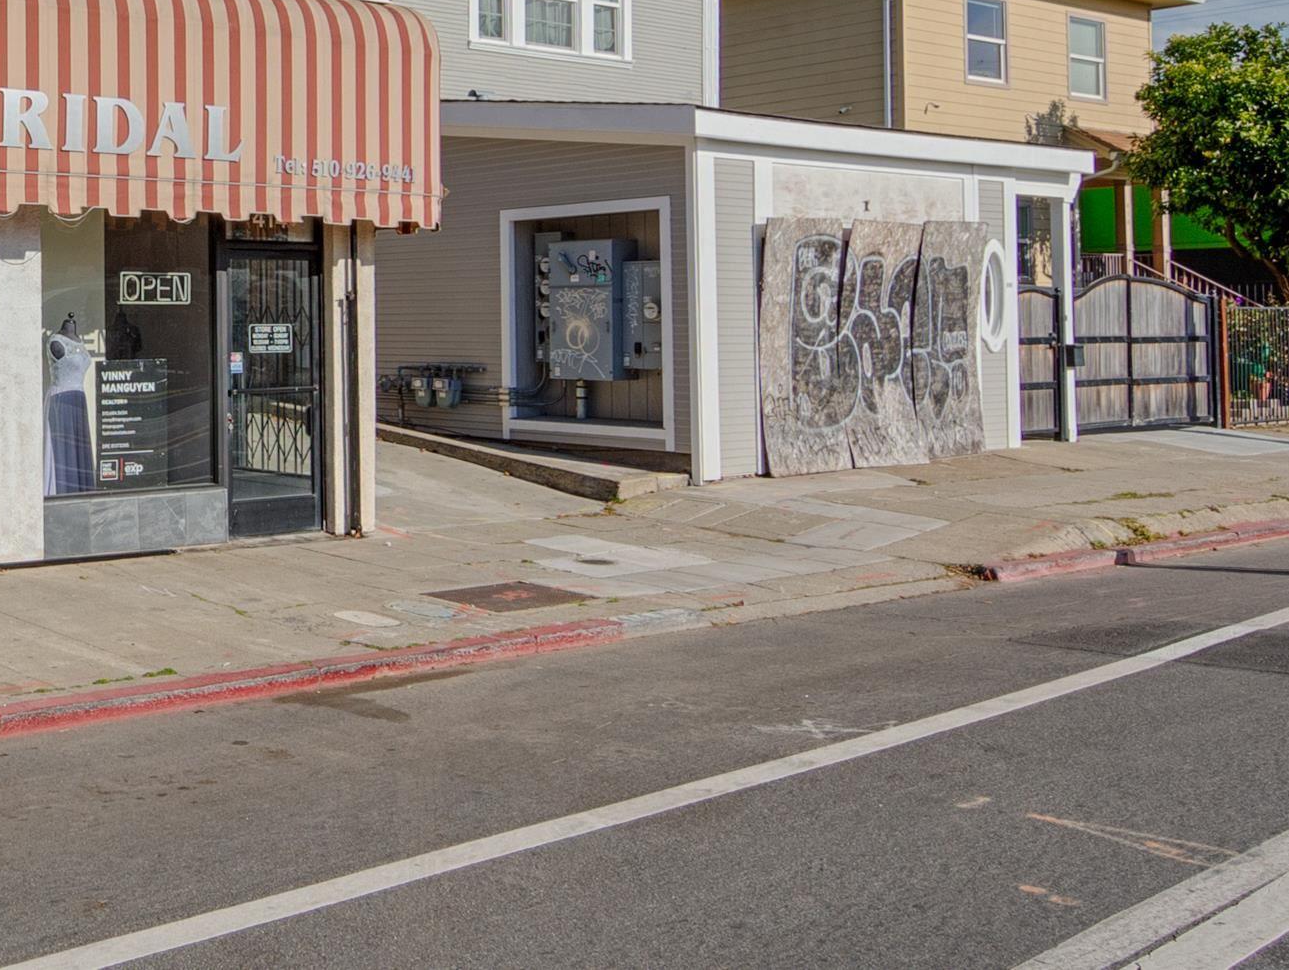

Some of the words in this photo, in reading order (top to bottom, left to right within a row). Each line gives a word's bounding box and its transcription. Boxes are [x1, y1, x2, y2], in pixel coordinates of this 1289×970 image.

[274, 154, 307, 177] Tel:
[123, 274, 188, 302] OPEN
[101, 370, 132, 381] VINNY
[101, 382, 156, 393] MANGUYEN
